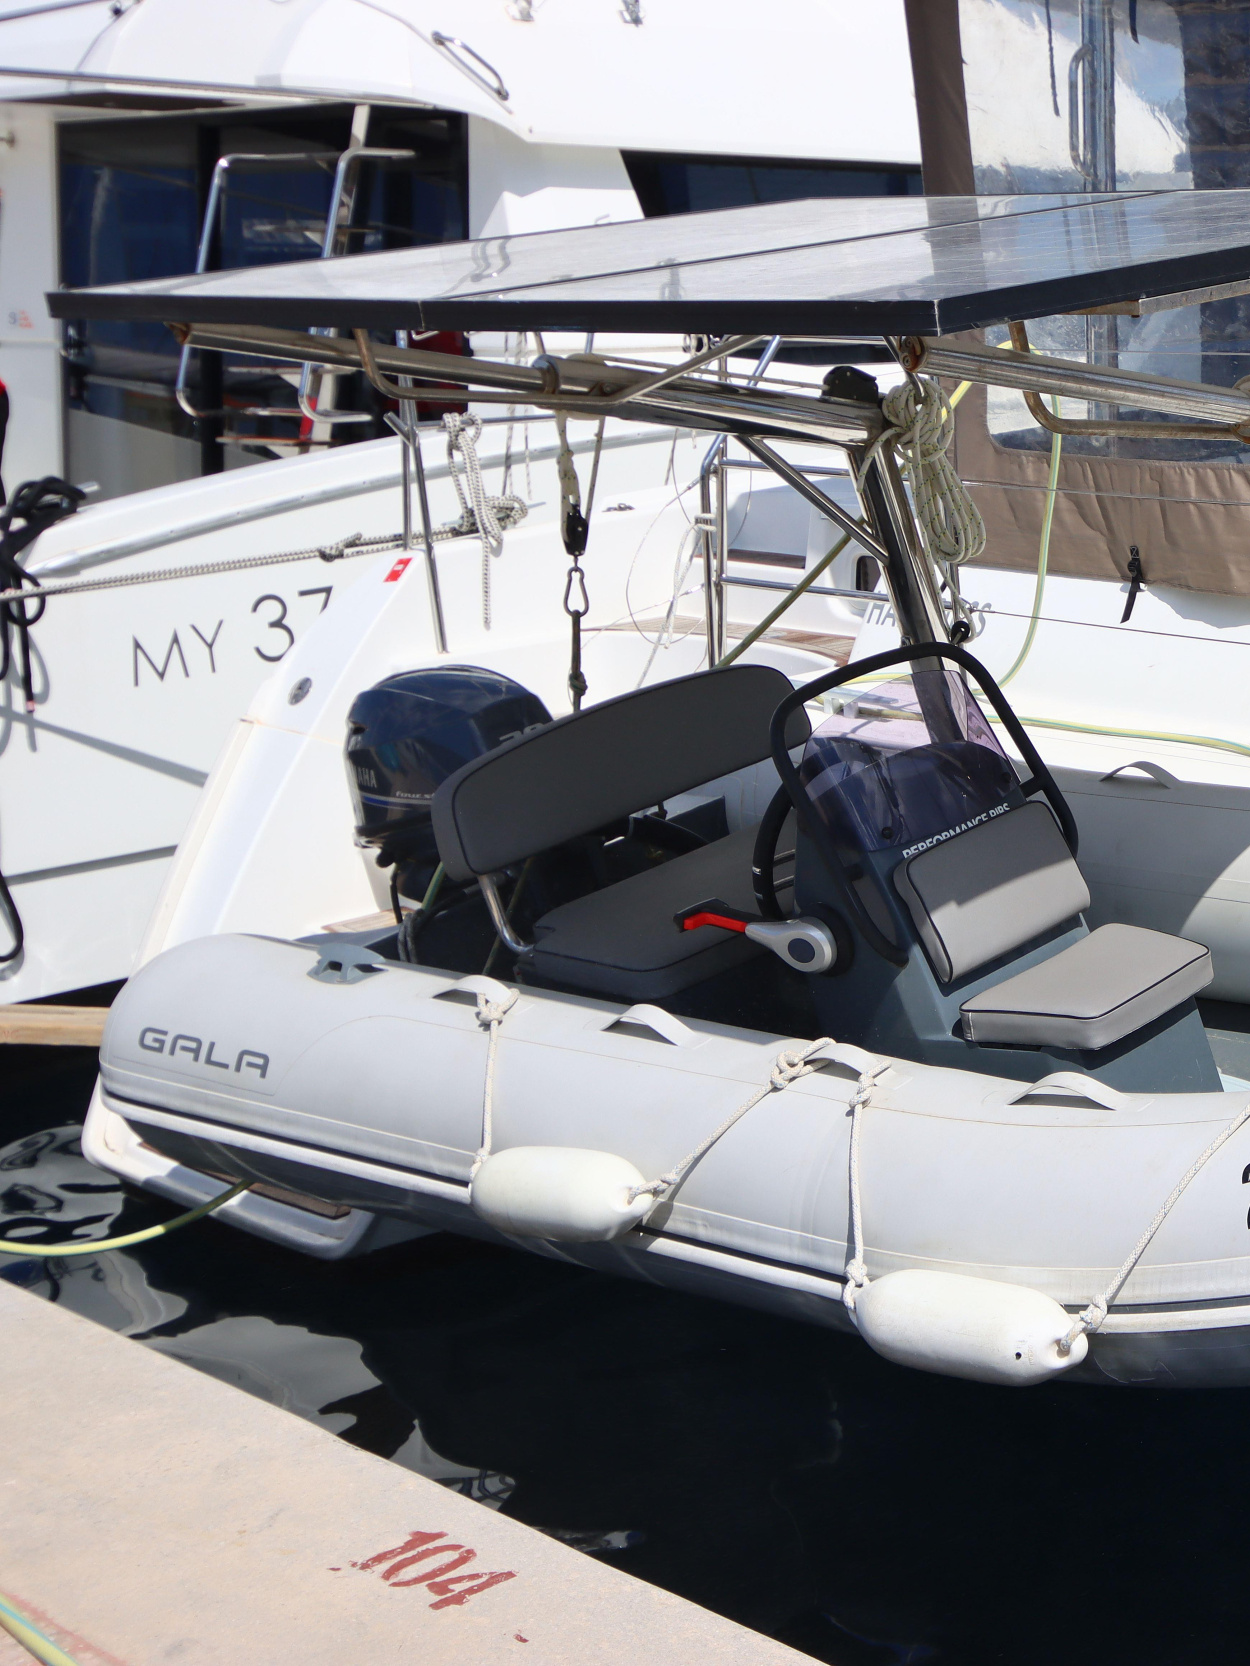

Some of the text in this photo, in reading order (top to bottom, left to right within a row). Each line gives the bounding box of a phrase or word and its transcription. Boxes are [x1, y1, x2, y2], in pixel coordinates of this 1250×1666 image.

[132, 619, 223, 687] MY
[138, 1026, 270, 1079] GALA
[349, 1530, 519, 1611] 104
